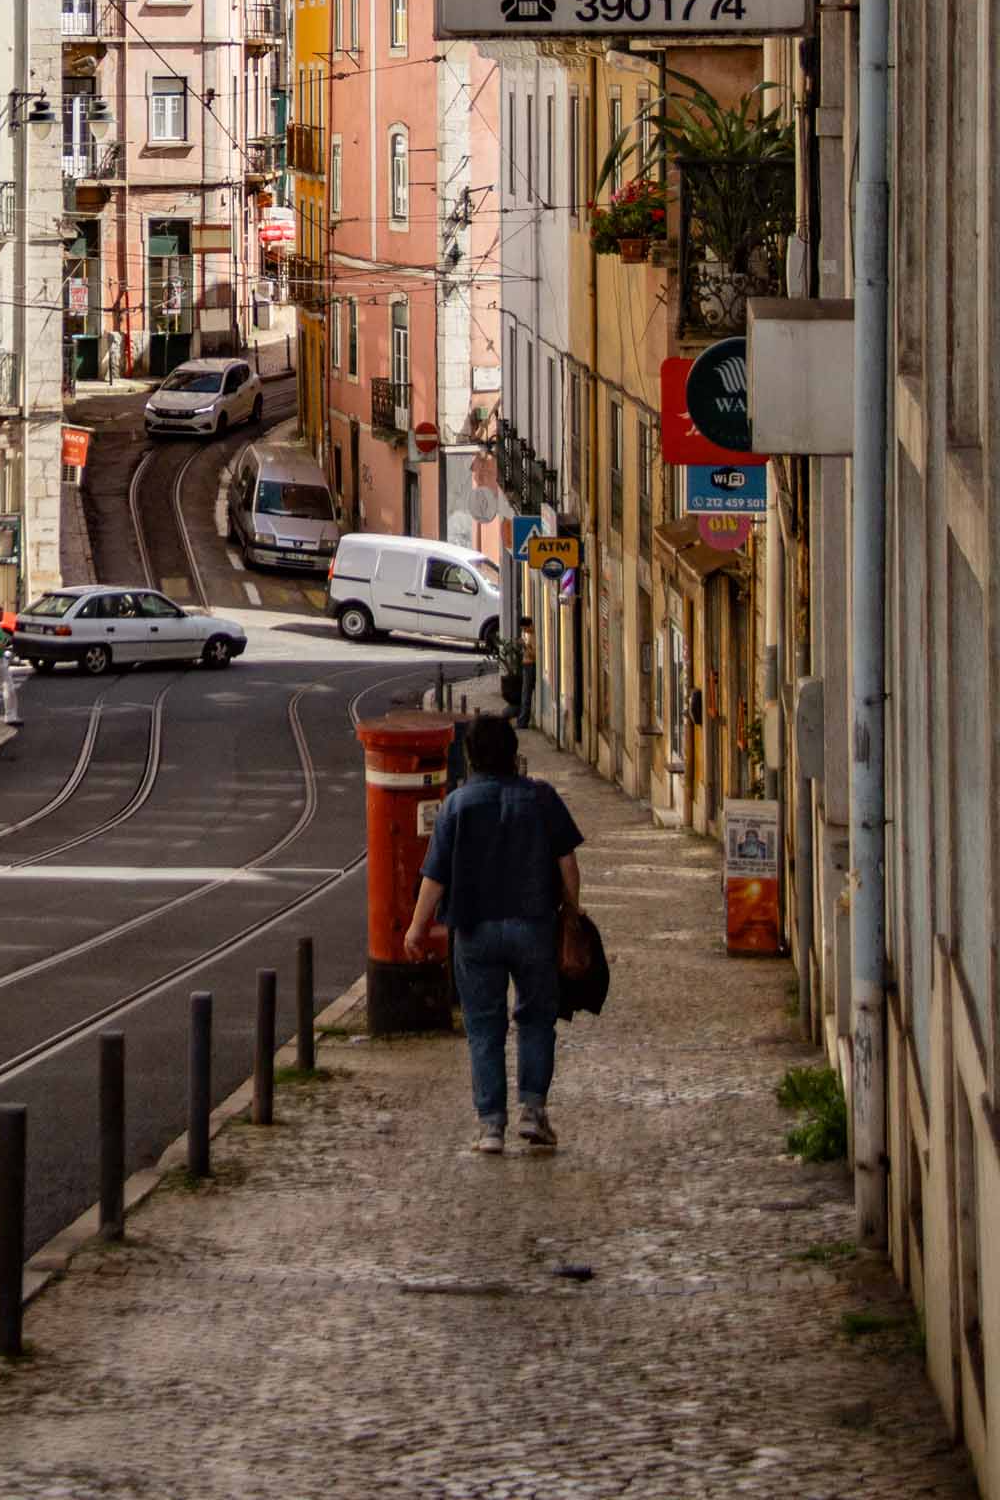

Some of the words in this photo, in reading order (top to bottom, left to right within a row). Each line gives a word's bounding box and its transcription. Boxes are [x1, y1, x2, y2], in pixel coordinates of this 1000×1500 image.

[705, 498, 722, 507] 212
[725, 498, 743, 508] 459
[537, 541, 570, 552] ATM
